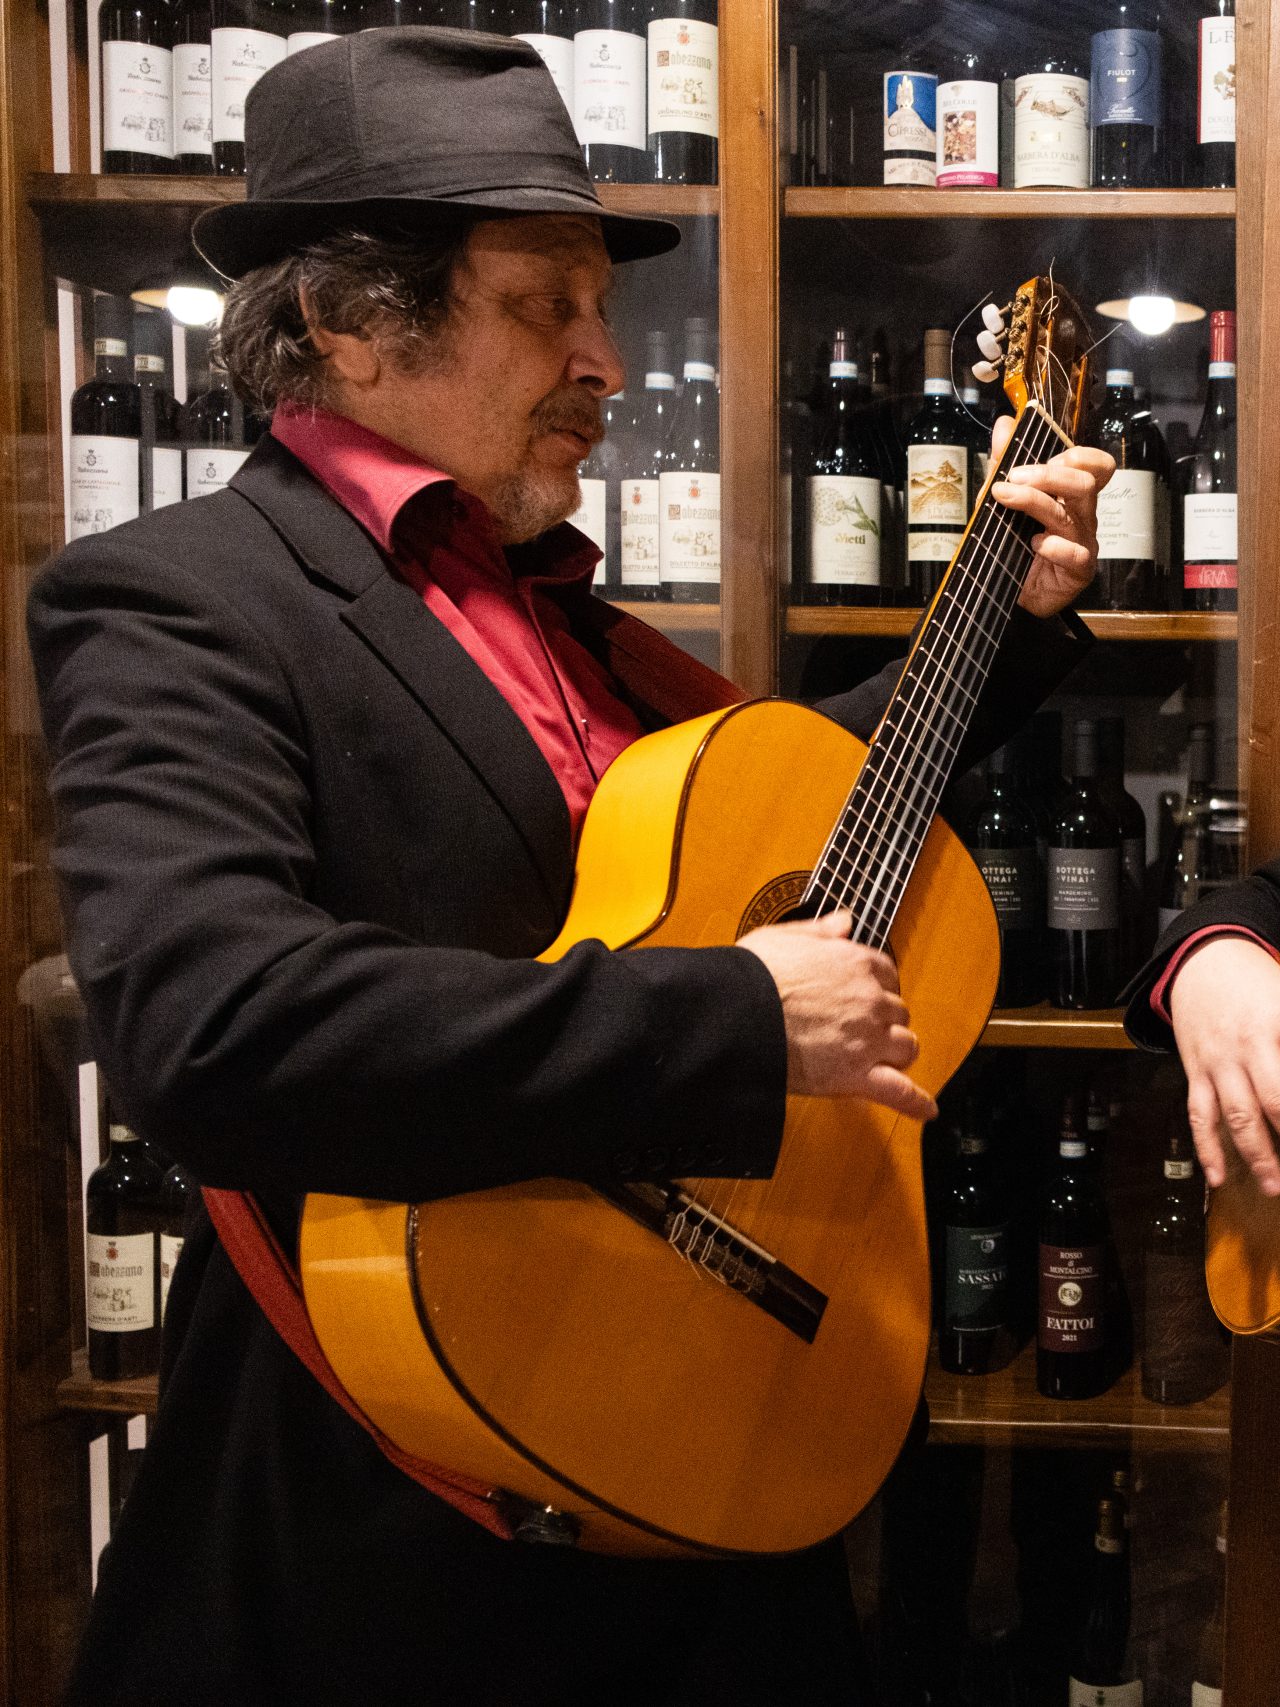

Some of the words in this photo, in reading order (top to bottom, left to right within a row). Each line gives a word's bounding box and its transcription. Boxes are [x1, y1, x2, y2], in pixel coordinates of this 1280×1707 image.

[1107, 69, 1136, 77] FIULOT
[981, 866, 1018, 875] OTTEGA
[1056, 866, 1096, 875] BOTTEGA
[1060, 876, 1089, 884] VINAI
[1059, 1251, 1083, 1260] ROSSO
[1049, 1266, 1093, 1275] MONTALCINO
[1046, 1316, 1096, 1331] FATTOI
